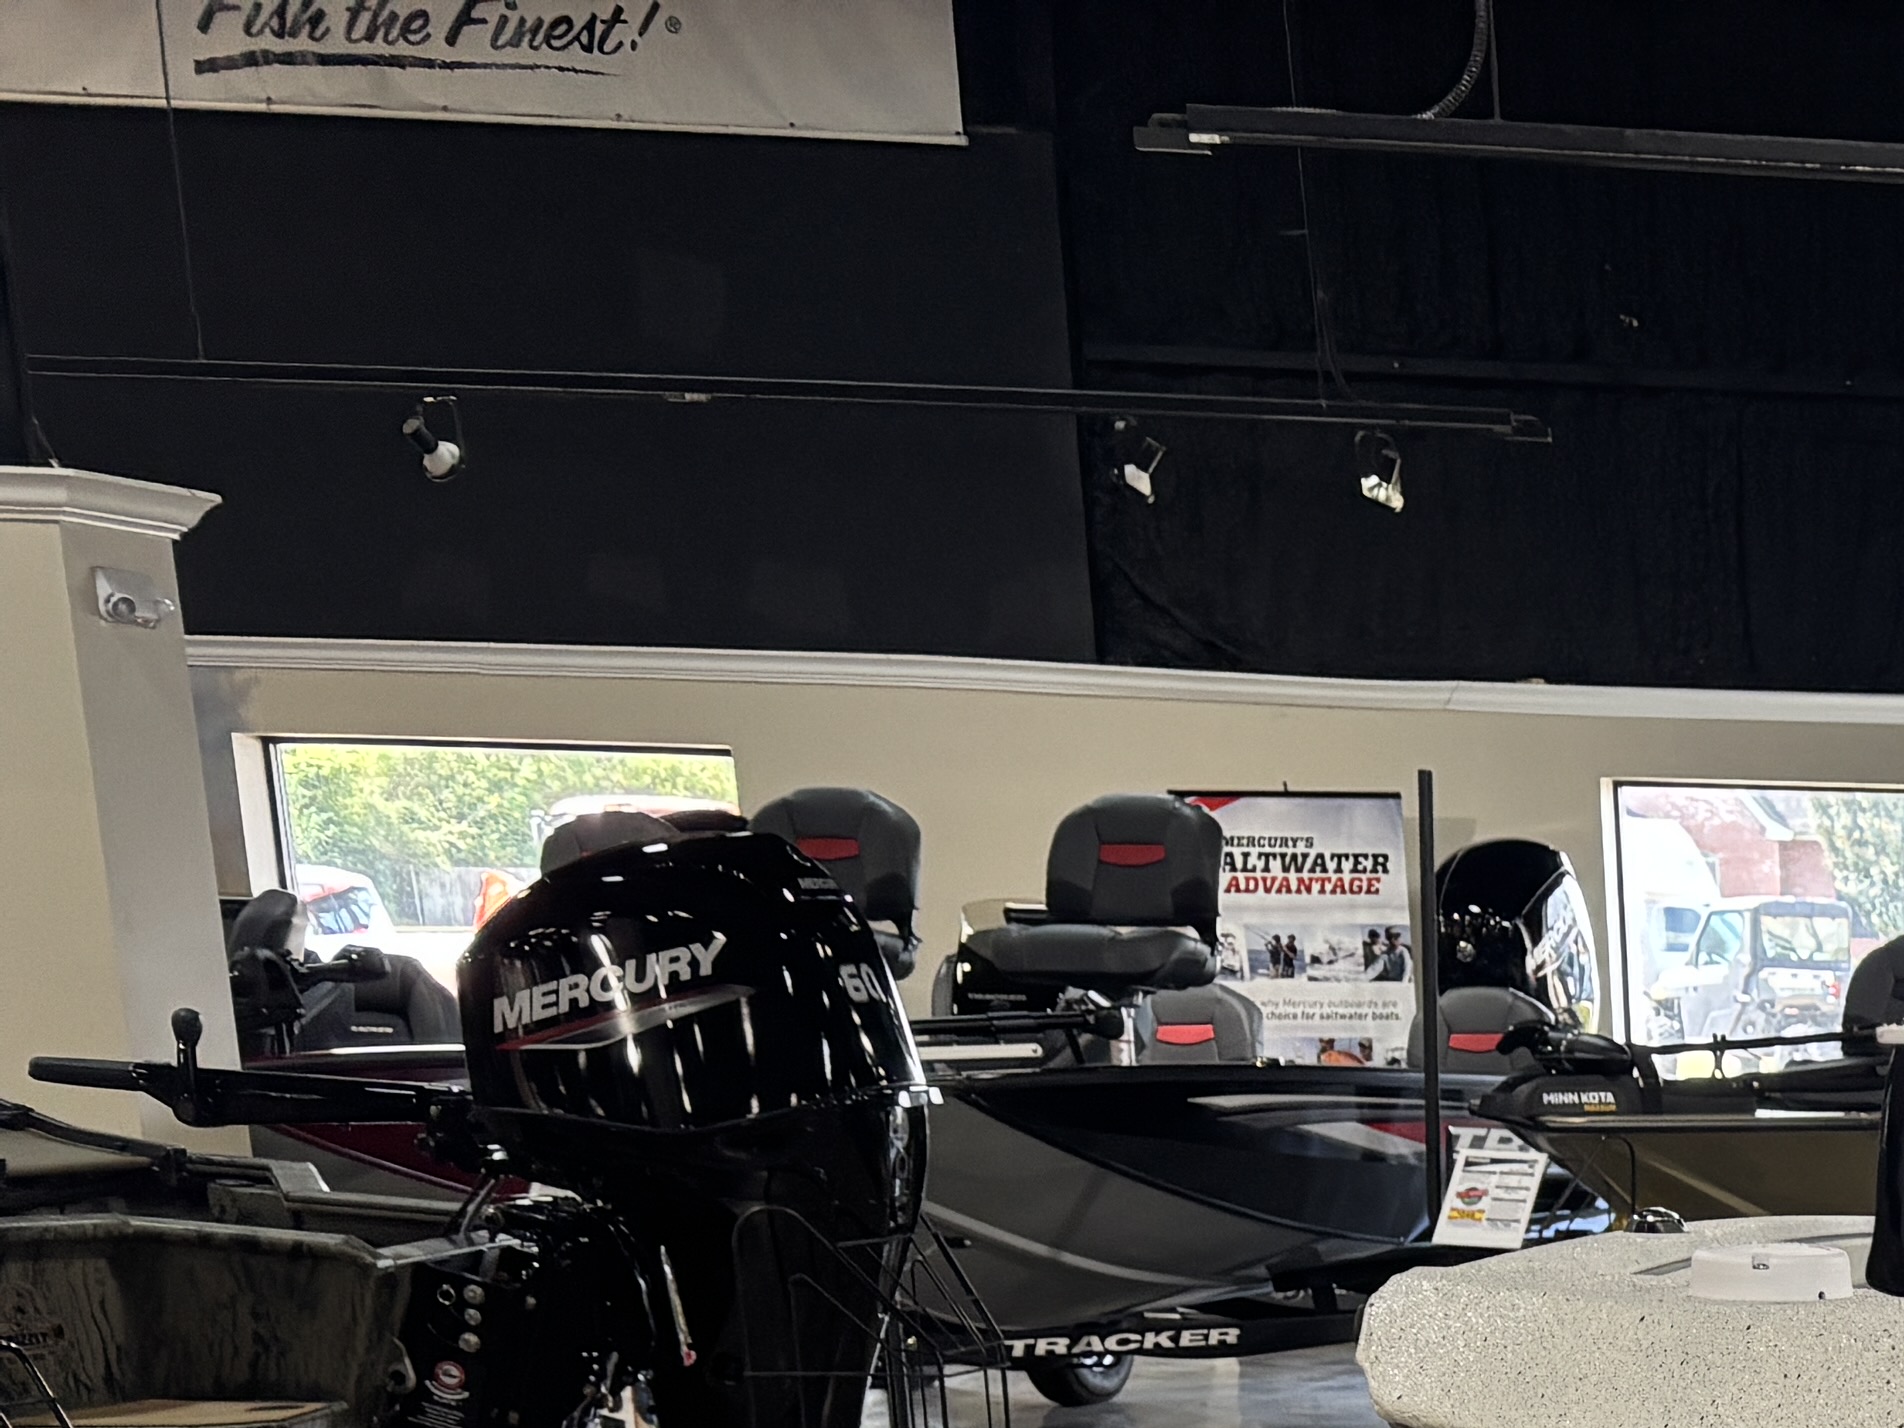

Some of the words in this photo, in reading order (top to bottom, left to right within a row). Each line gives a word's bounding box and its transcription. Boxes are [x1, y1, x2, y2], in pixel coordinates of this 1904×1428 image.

[343, 0, 432, 47] the
[1222, 851, 1390, 874] ALTWATER
[1223, 876, 1382, 895] ADVANTAGE
[493, 930, 728, 1034] MERCURY
[838, 961, 888, 1004] 60
[1282, 997, 1324, 1010] Mercury
[1327, 999, 1378, 1009] outboards
[1266, 1010, 1299, 1021] choice
[1302, 1010, 1315, 1021] for
[1319, 1010, 1368, 1021] saltwater
[1542, 1092, 1580, 1105] MINN
[1581, 1091, 1616, 1104] KOTA
[1003, 1327, 1241, 1358] TRACKER
